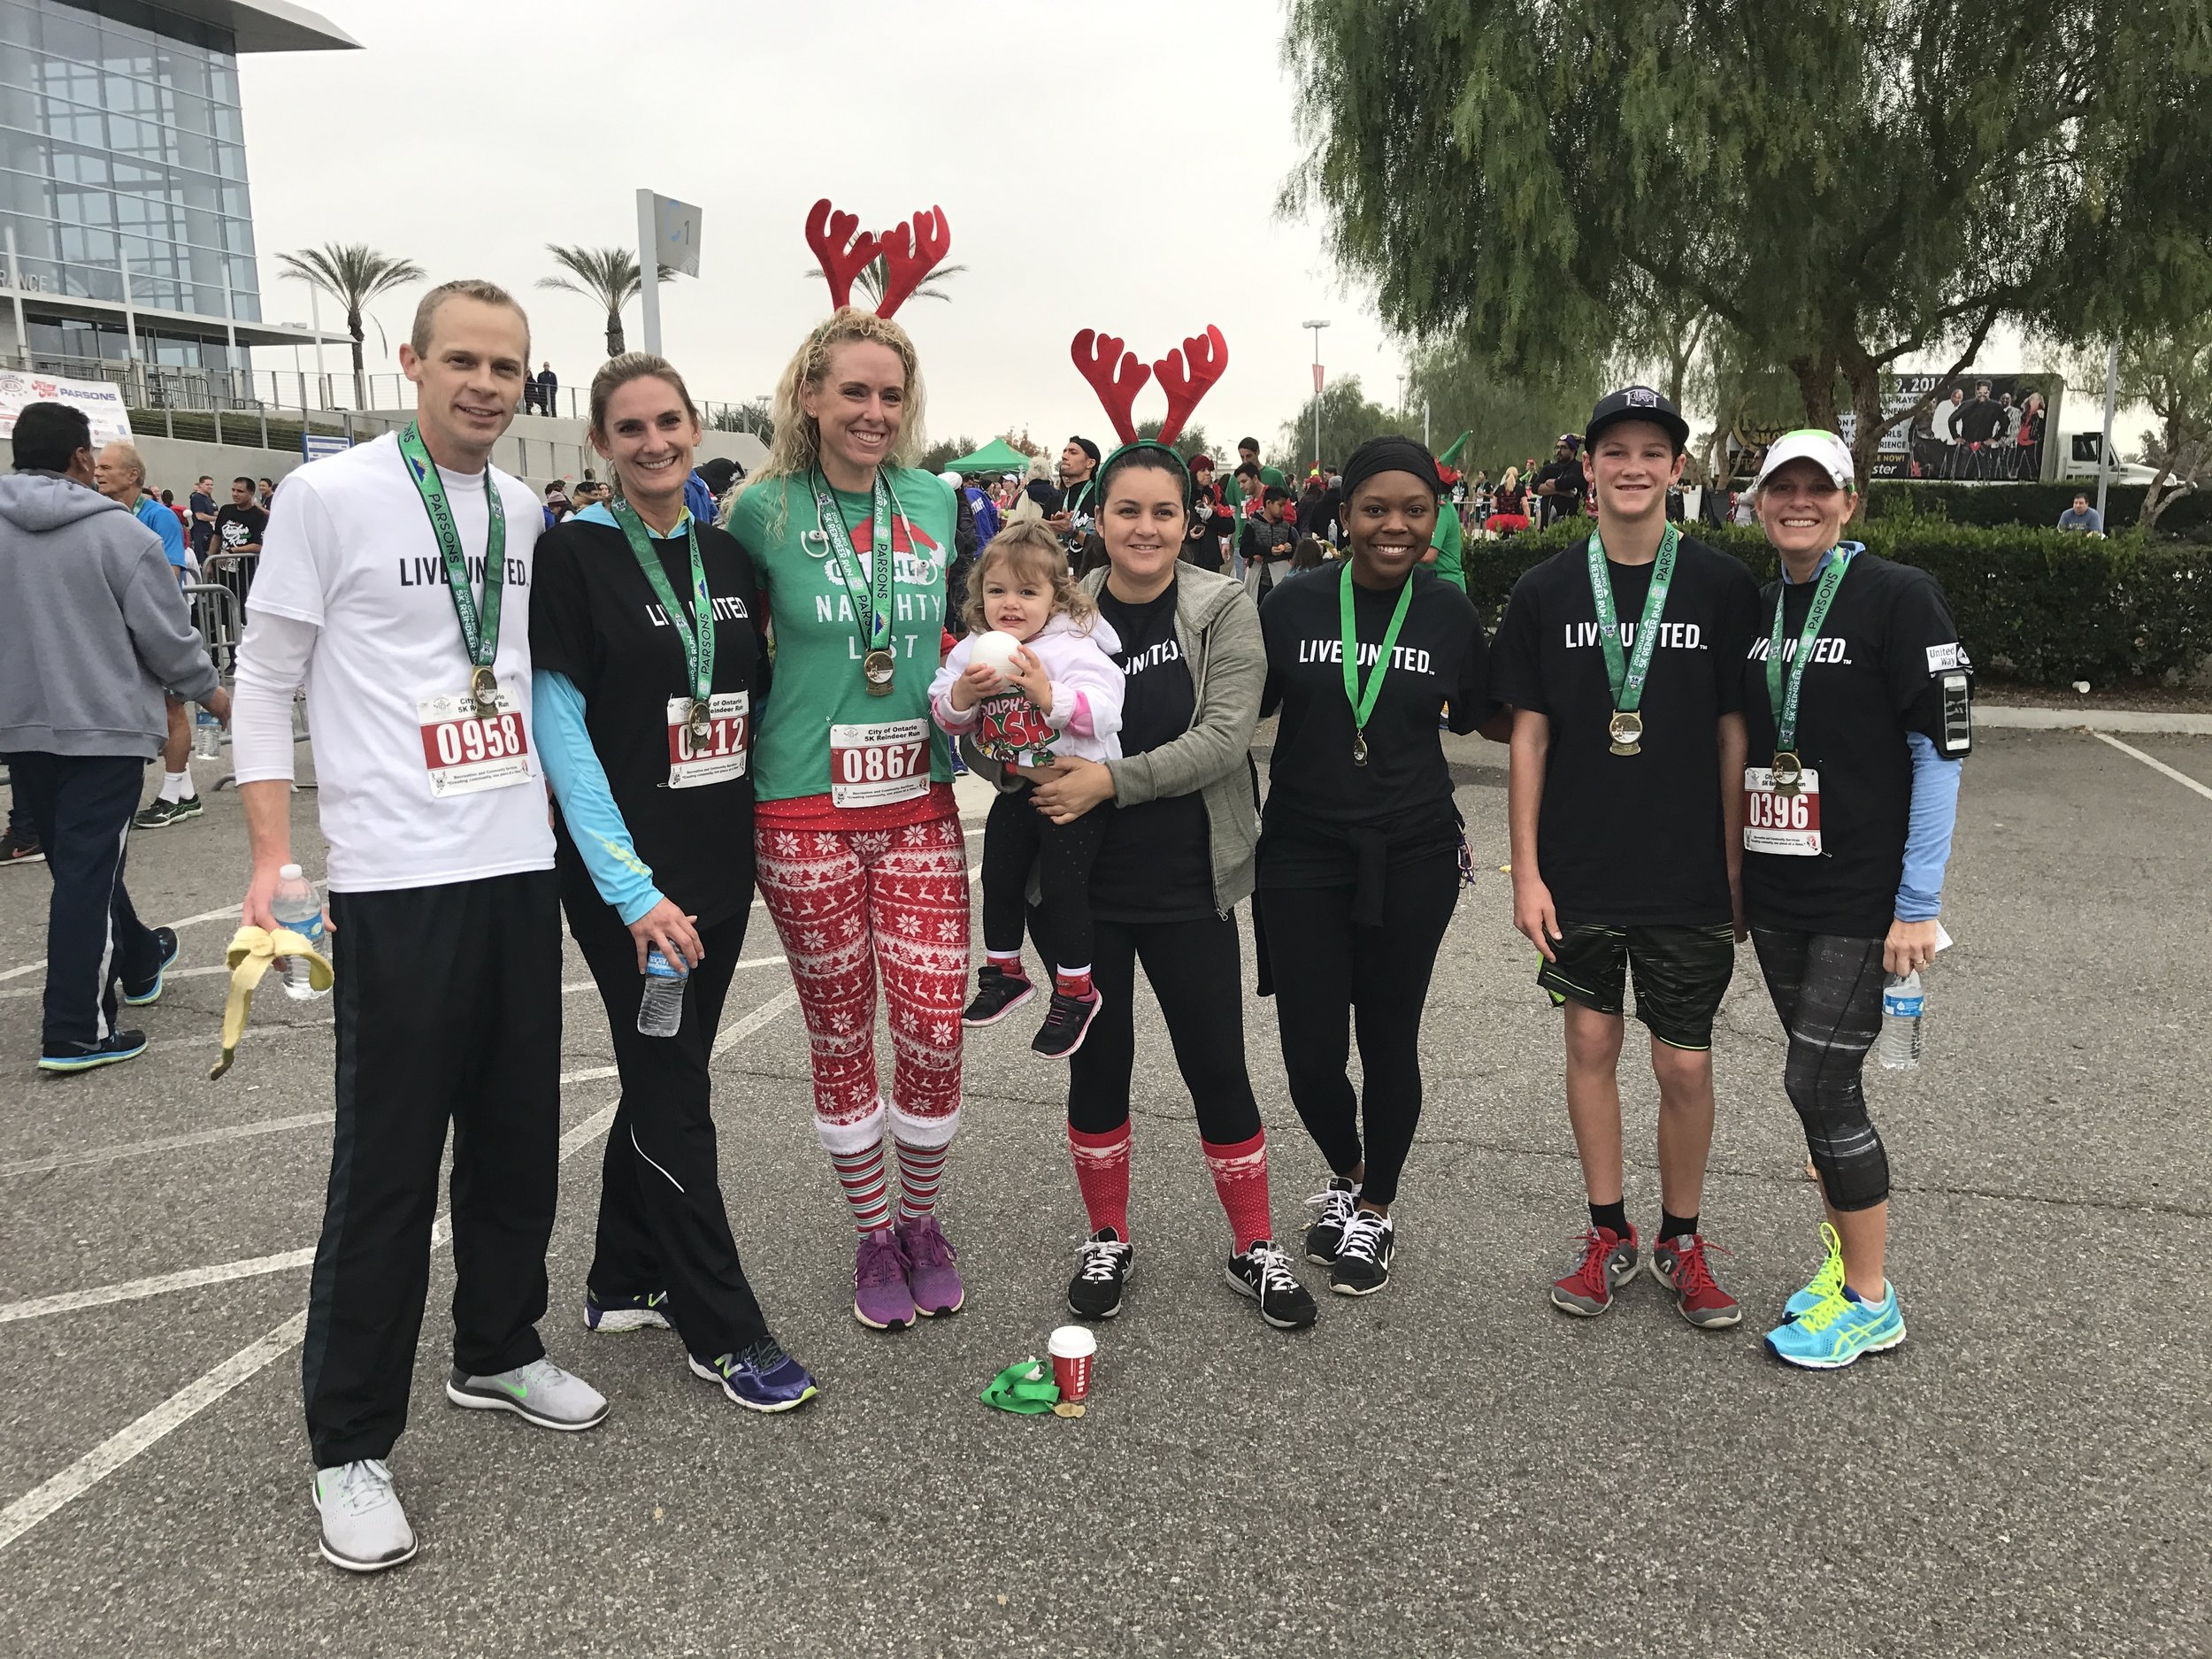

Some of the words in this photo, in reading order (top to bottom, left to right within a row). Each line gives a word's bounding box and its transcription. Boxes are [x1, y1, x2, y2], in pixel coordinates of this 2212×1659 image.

[0, 270, 48, 293] RNCE
[59, 388, 117, 401] PARSONS
[1911, 377, 1944, 392] 201
[428, 494, 460, 564] PARSONS
[824, 513, 833, 523] 5K
[827, 524, 848, 559] REINDEER
[836, 524, 848, 547] ONTARIO
[841, 559, 854, 577] RUN
[1589, 554, 1597, 563] 5K
[1656, 529, 1675, 581] PARSONS
[878, 543, 888, 599] PARSONS
[1591, 564, 1603, 600] REINDEER
[456, 589, 465, 603] 5K
[816, 593, 941, 623] NAHTY
[1808, 572, 1839, 630] PARSONS
[467, 605, 478, 634] ONTARIO
[1596, 601, 1607, 618] RUN
[1651, 601, 1663, 618] RUN
[460, 603, 476, 649] REINDEER
[1565, 623, 1601, 648] LIV
[1620, 623, 1701, 649] UTED
[1641, 619, 1658, 657] REINDEER
[687, 635, 697, 655] RUN
[700, 612, 711, 675] PARSONS
[849, 634, 918, 660] LST
[1637, 630, 1647, 654] ONTARIO
[1929, 646, 1955, 658] United
[1299, 640, 1343, 664] LIVE
[1356, 642, 1430, 673] UNTED
[1639, 658, 1648, 669] 5K
[1798, 649, 1808, 668] RUN
[1940, 657, 1955, 667] Way
[1790, 669, 1802, 709] REINDEER
[976, 710, 1056, 748] ASH
[1788, 710, 1796, 722] 5K
[437, 715, 520, 764] 0958
[876, 733, 906, 741] Reindeer
[842, 741, 922, 782] 0867
[1750, 793, 1809, 828] 0396
